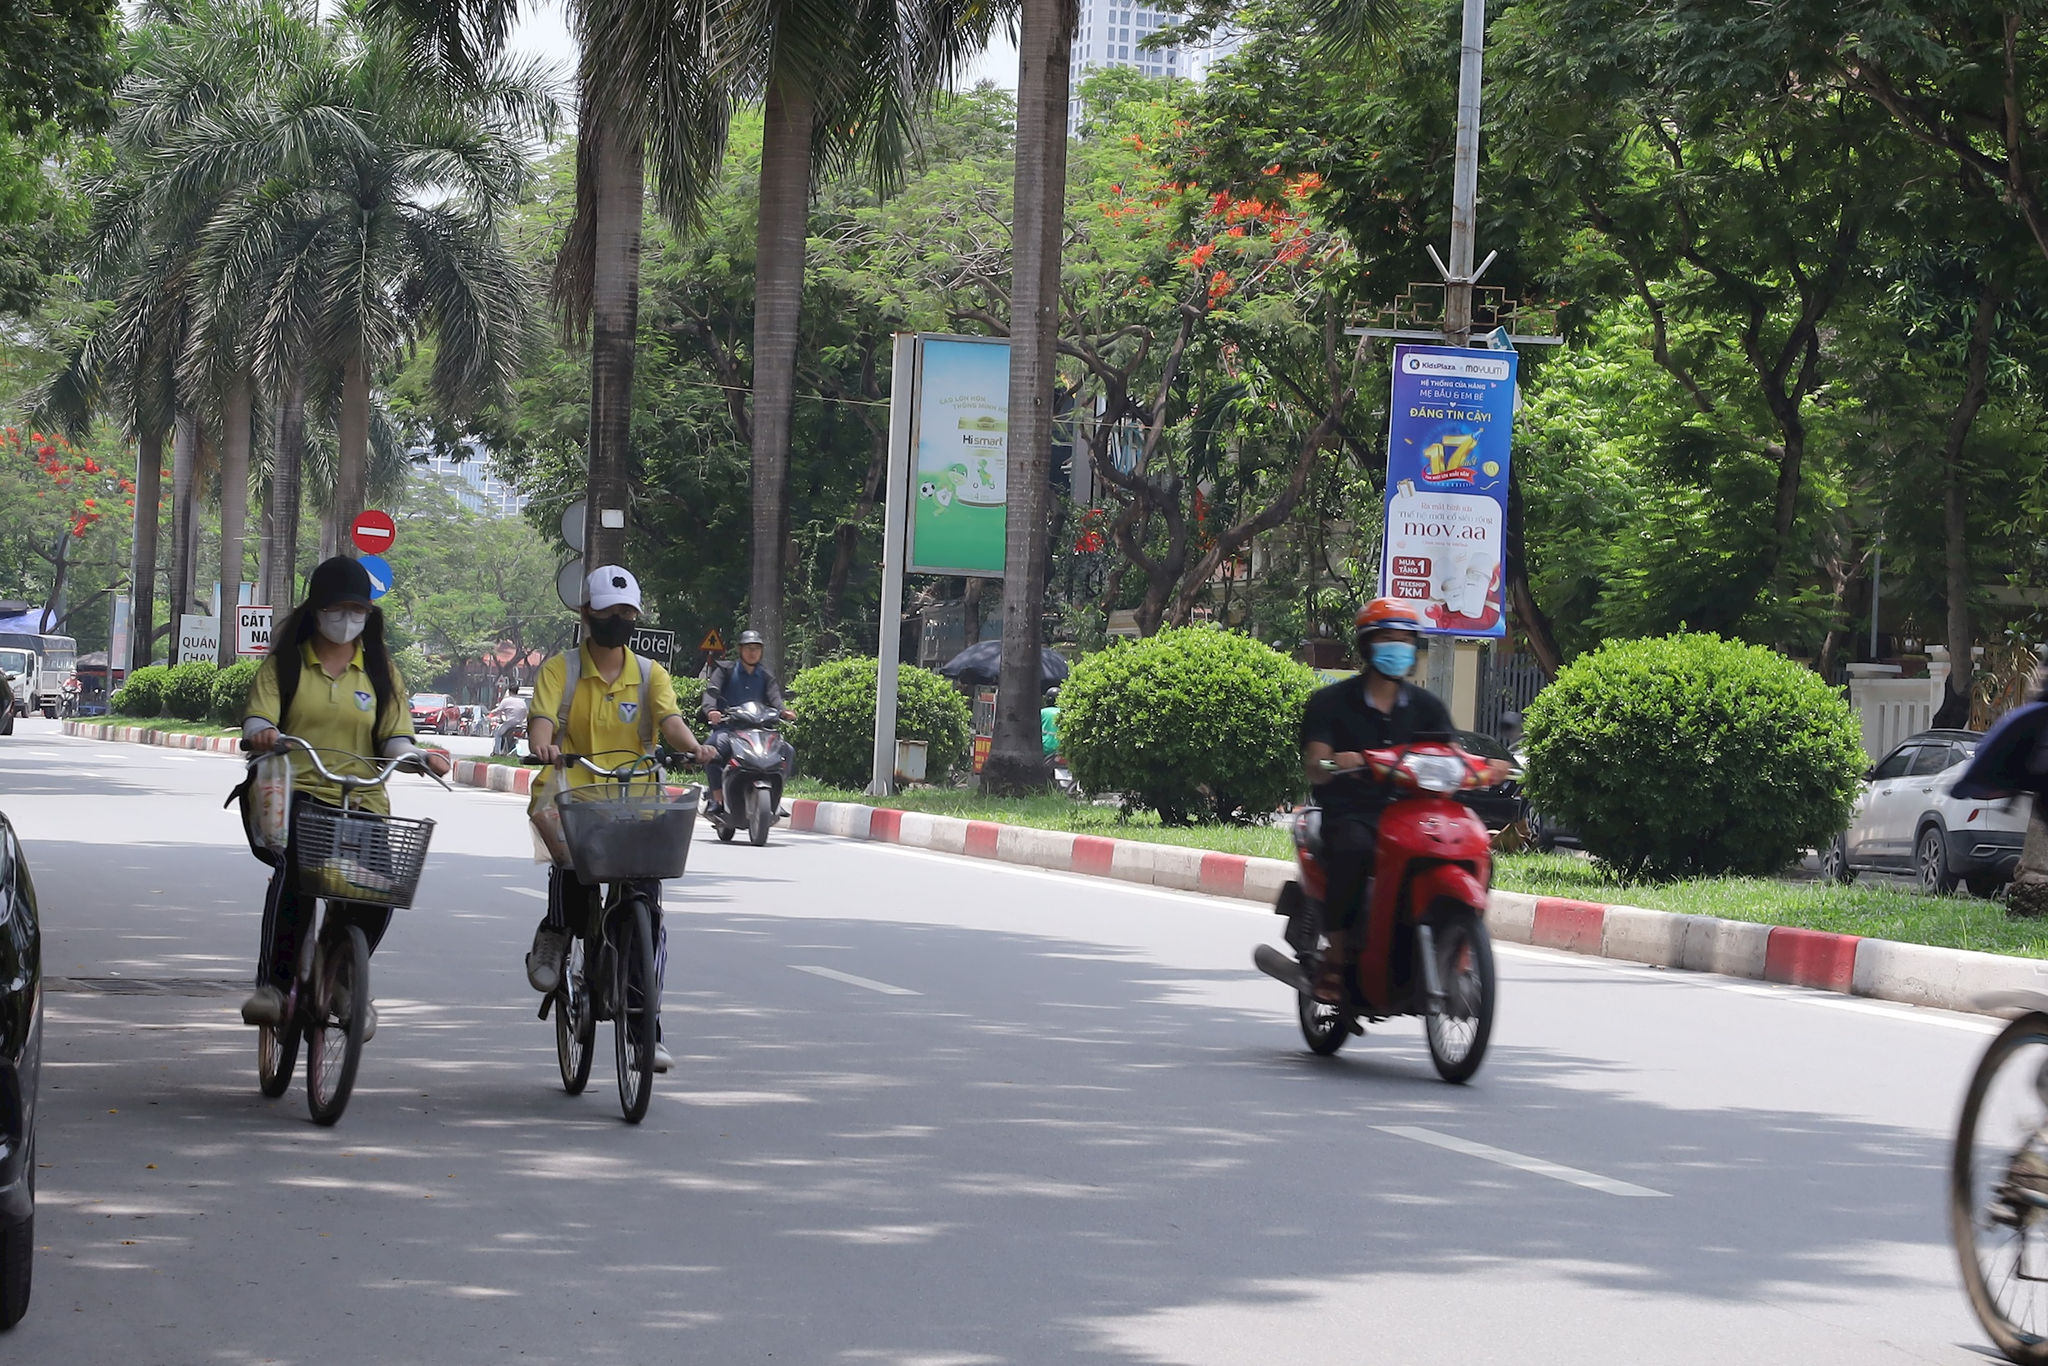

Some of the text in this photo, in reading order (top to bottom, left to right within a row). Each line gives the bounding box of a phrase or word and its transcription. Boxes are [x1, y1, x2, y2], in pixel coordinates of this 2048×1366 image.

[1410, 406, 1444, 419] ĐÁNG
[1446, 410, 1463, 420] TIN
[1404, 522, 1486, 540] mov.aa
[1418, 560, 1425, 574] 1
[1399, 587, 1422, 597] 7KM
[183, 636, 216, 648] QUÁN
[252, 631, 272, 642] NA
[628, 631, 671, 654] Hotel
